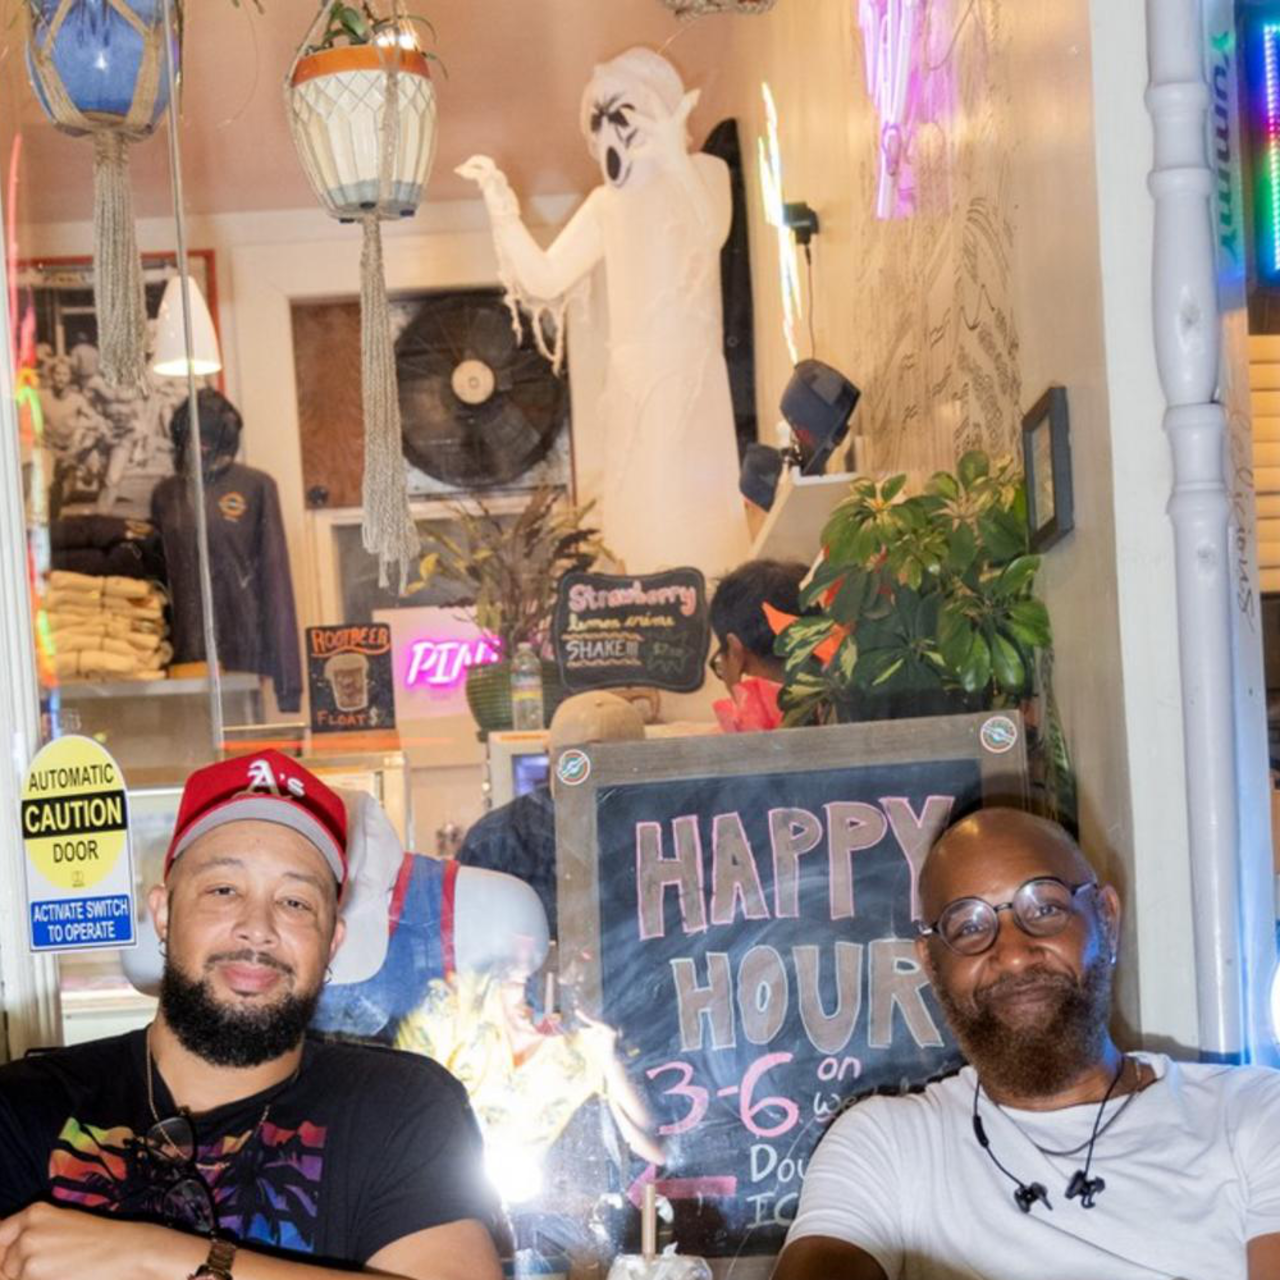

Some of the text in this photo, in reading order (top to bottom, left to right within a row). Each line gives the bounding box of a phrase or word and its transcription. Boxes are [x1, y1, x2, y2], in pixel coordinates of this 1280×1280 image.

[28, 762, 115, 793] AUTOMATIC
[25, 796, 123, 834] CAUTION
[53, 840, 99, 863] DOOR
[635, 795, 955, 941] HAPPY
[33, 897, 129, 922] ACTIVATE SWITCH
[47, 920, 117, 943] TO OPERATE
[670, 938, 945, 1055] HOUR
[645, 1052, 862, 1137] 3-6 on
[750, 1144, 809, 1184] Dou
